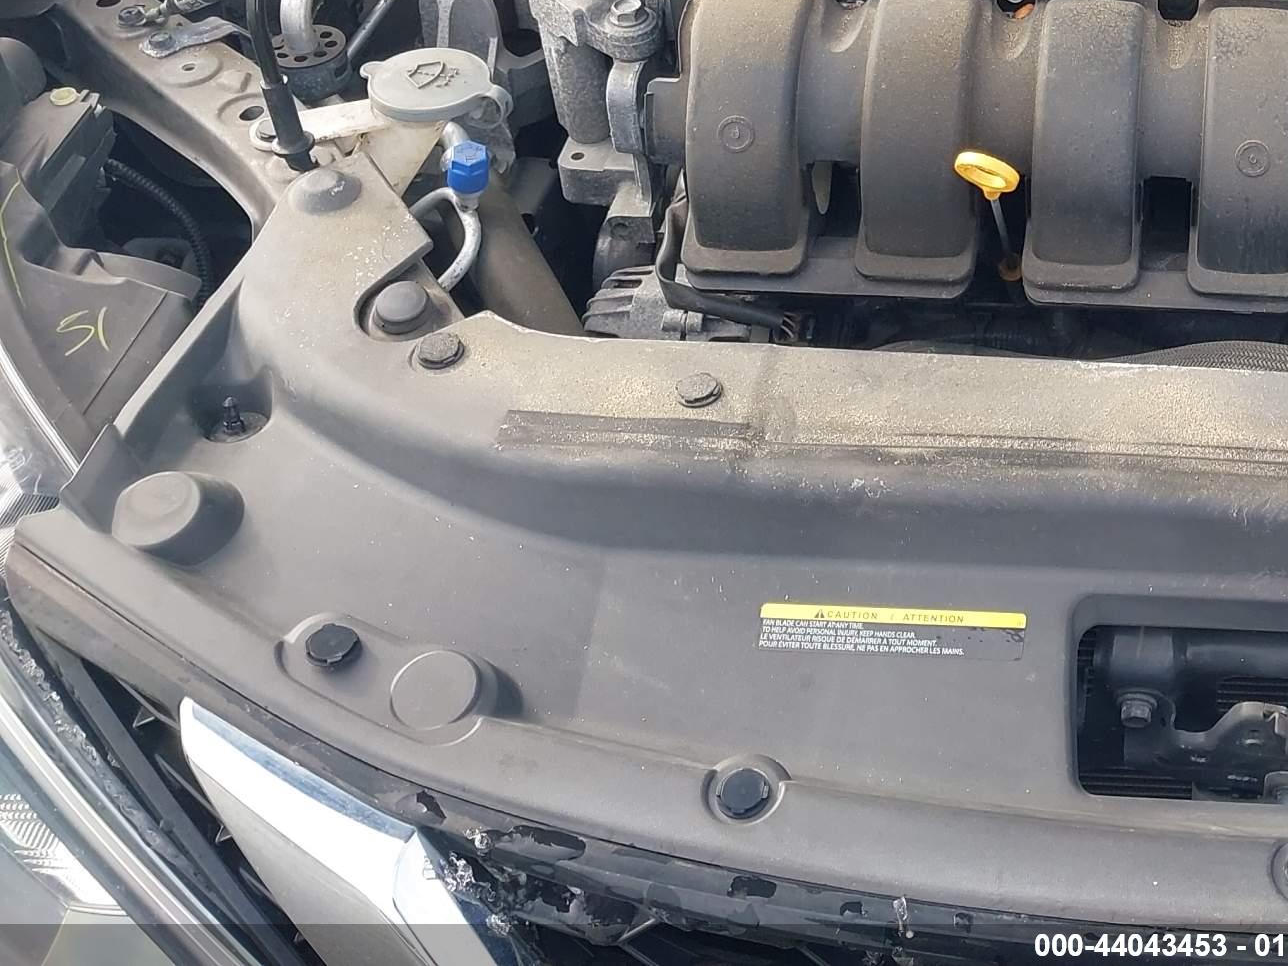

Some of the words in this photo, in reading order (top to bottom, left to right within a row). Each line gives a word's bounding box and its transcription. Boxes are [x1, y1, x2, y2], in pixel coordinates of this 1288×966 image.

[827, 610, 878, 620] CAUTION
[903, 613, 965, 624] ATTENTION
[806, 628, 837, 636] PERSONAL
[769, 634, 811, 642] VENTILATEUR
[801, 642, 822, 650] TOUTE
[856, 644, 867, 652] NE
[889, 646, 929, 654] APPROCHER
[930, 647, 941, 655] LES
